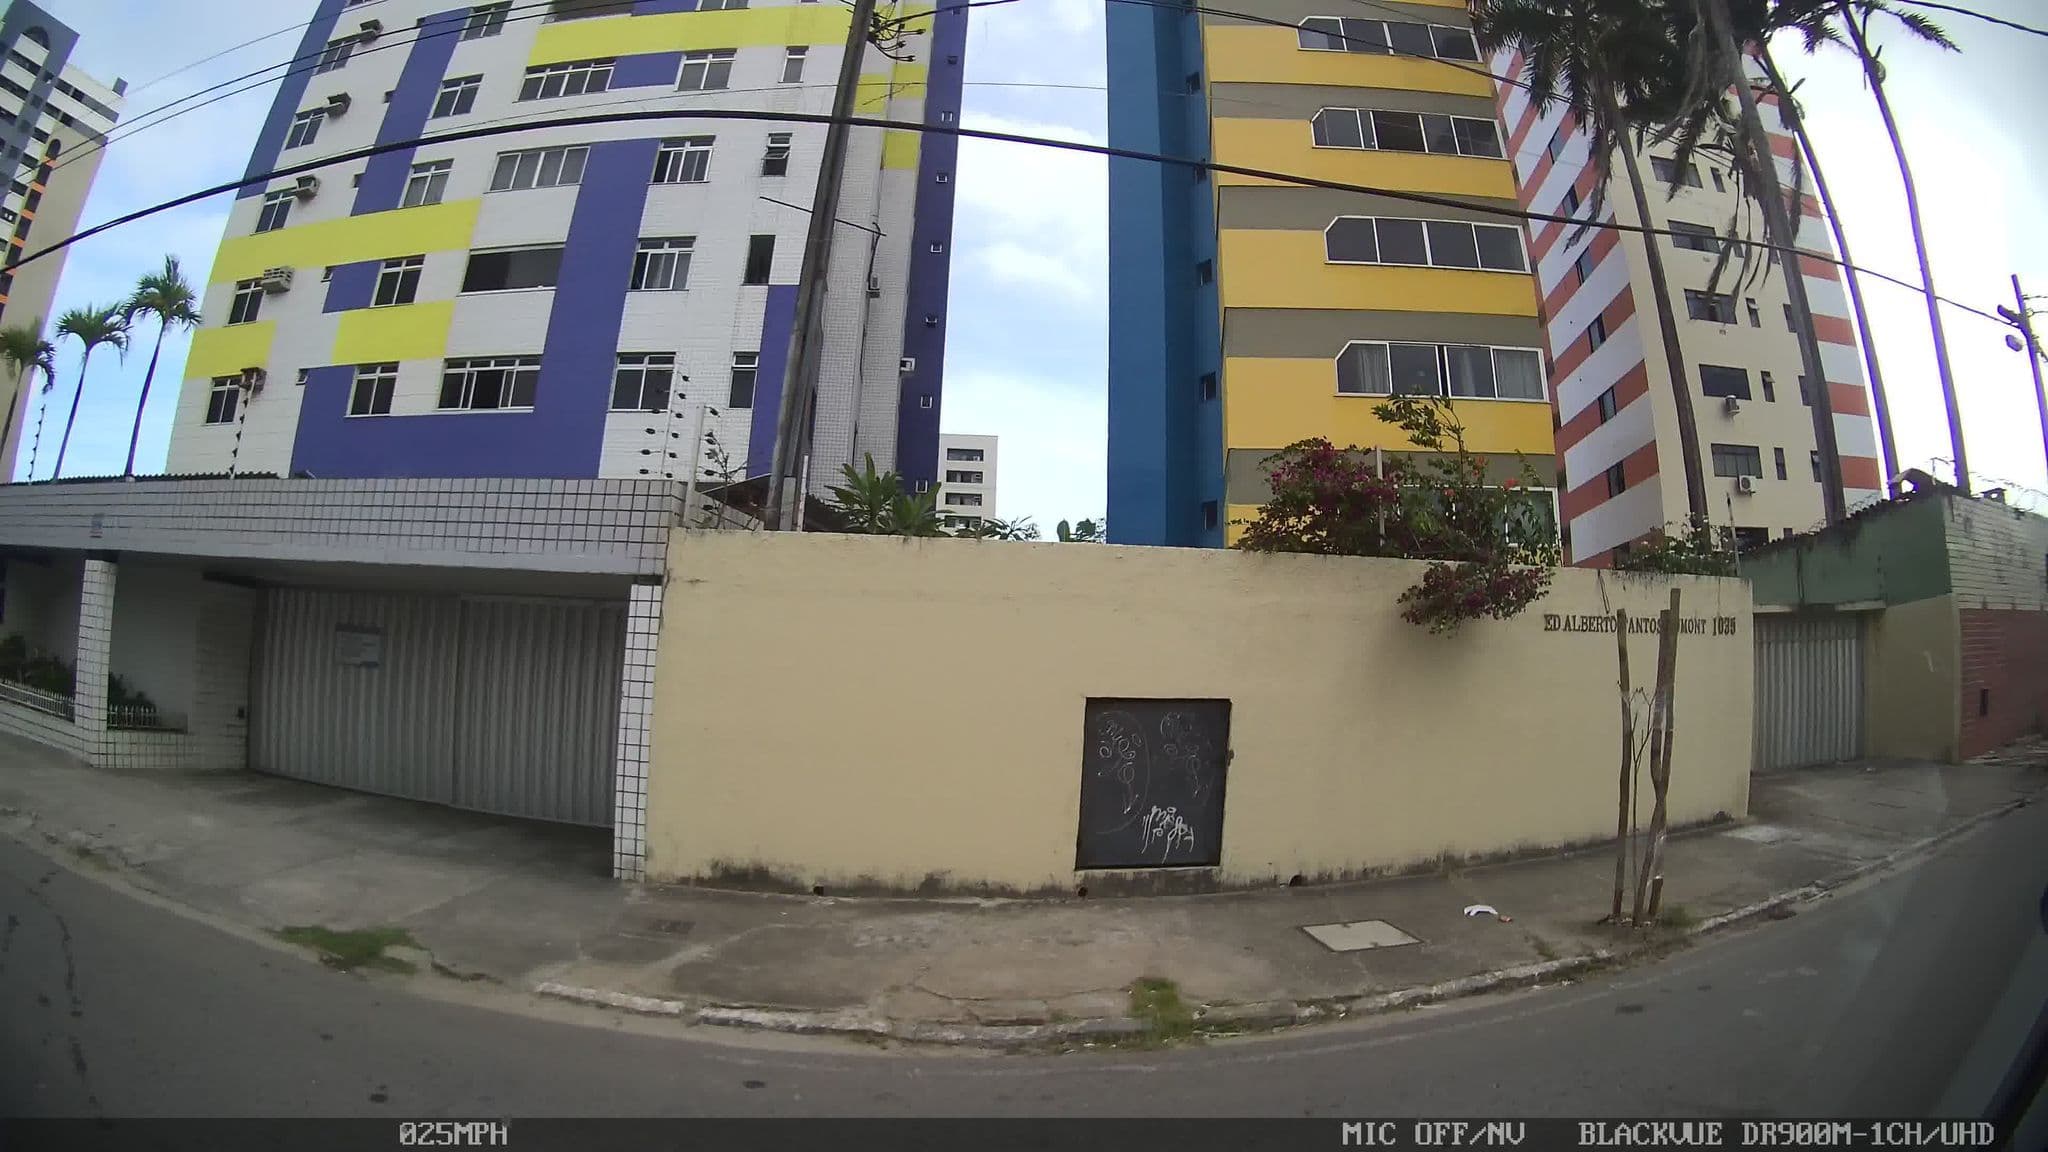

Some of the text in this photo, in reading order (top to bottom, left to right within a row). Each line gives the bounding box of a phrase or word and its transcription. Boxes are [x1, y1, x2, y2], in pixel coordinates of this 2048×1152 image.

[1543, 614, 1561, 632] ED
[1563, 614, 1617, 633] ALBERTO
[1625, 617, 1662, 634] ANTOS
[1678, 617, 1707, 635] MONT
